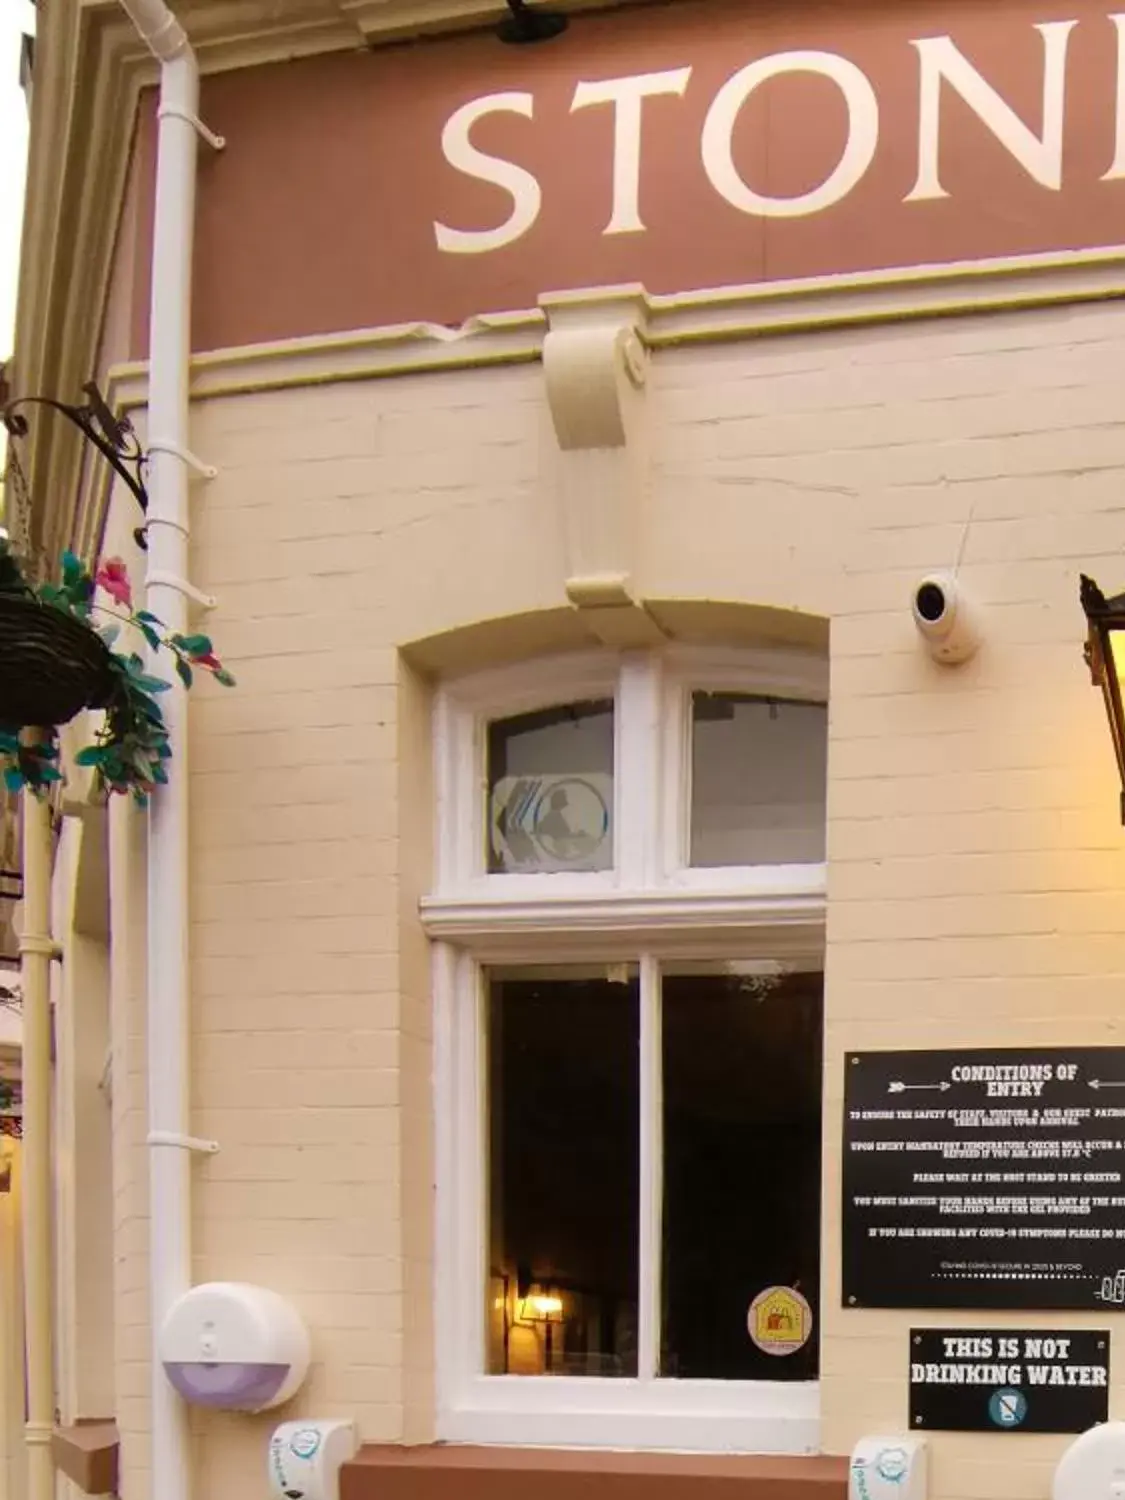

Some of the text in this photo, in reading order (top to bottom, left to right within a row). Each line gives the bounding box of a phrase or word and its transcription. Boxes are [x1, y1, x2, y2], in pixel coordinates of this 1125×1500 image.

[951, 1063, 1079, 1082] CONDITIONS OF
[986, 1081, 1046, 1097] ENTRY
[914, 1173, 944, 1182] PLEASE
[942, 1337, 1071, 1359] THIS IS NOT
[911, 1364, 1107, 1386] DRINKING WATER
